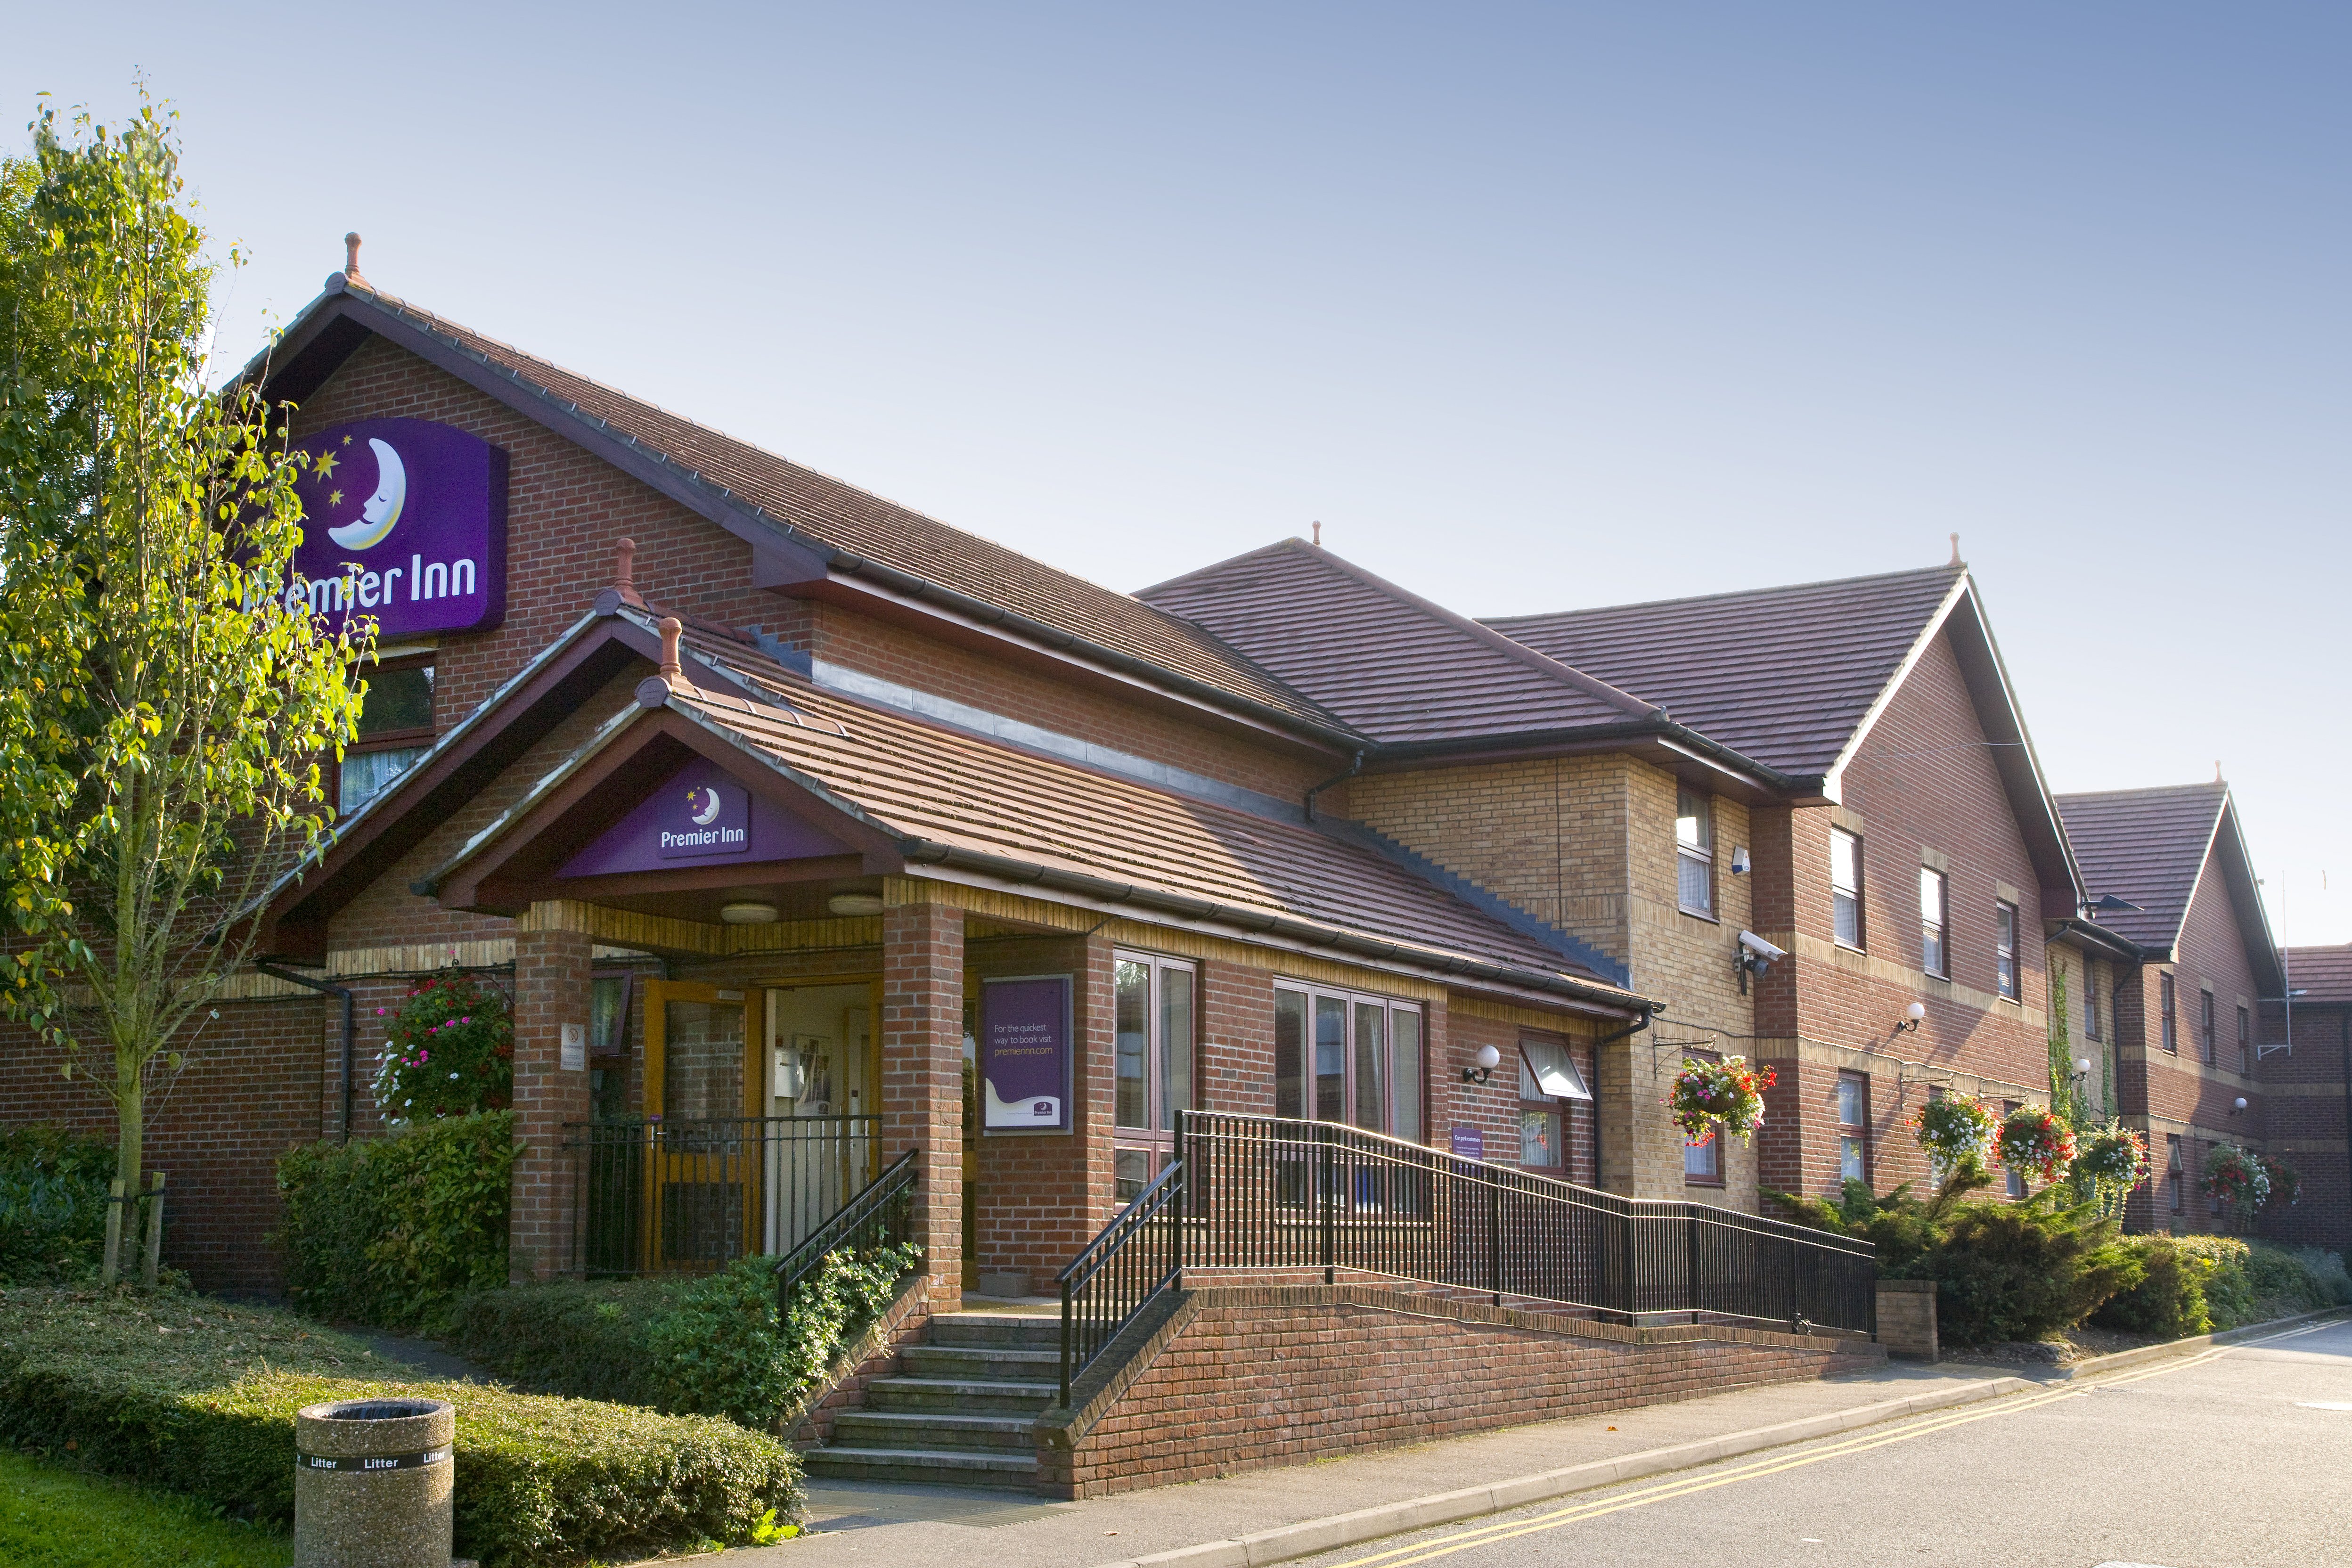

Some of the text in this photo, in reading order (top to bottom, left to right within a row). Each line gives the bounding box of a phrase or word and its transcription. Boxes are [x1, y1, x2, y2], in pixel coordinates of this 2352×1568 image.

[411, 554, 475, 601] Inn
[661, 826, 744, 848] Premier Inn
[995, 1023, 1047, 1034] For the quickest
[995, 1038, 1008, 1046] way
[1020, 1035, 1037, 1044] book
[1039, 1034, 1052, 1043] visit
[995, 1046, 1053, 1058] premierinn.com
[311, 1457, 337, 1469] Litter
[424, 1451, 445, 1463] Litter
[364, 1459, 398, 1469] Litter
